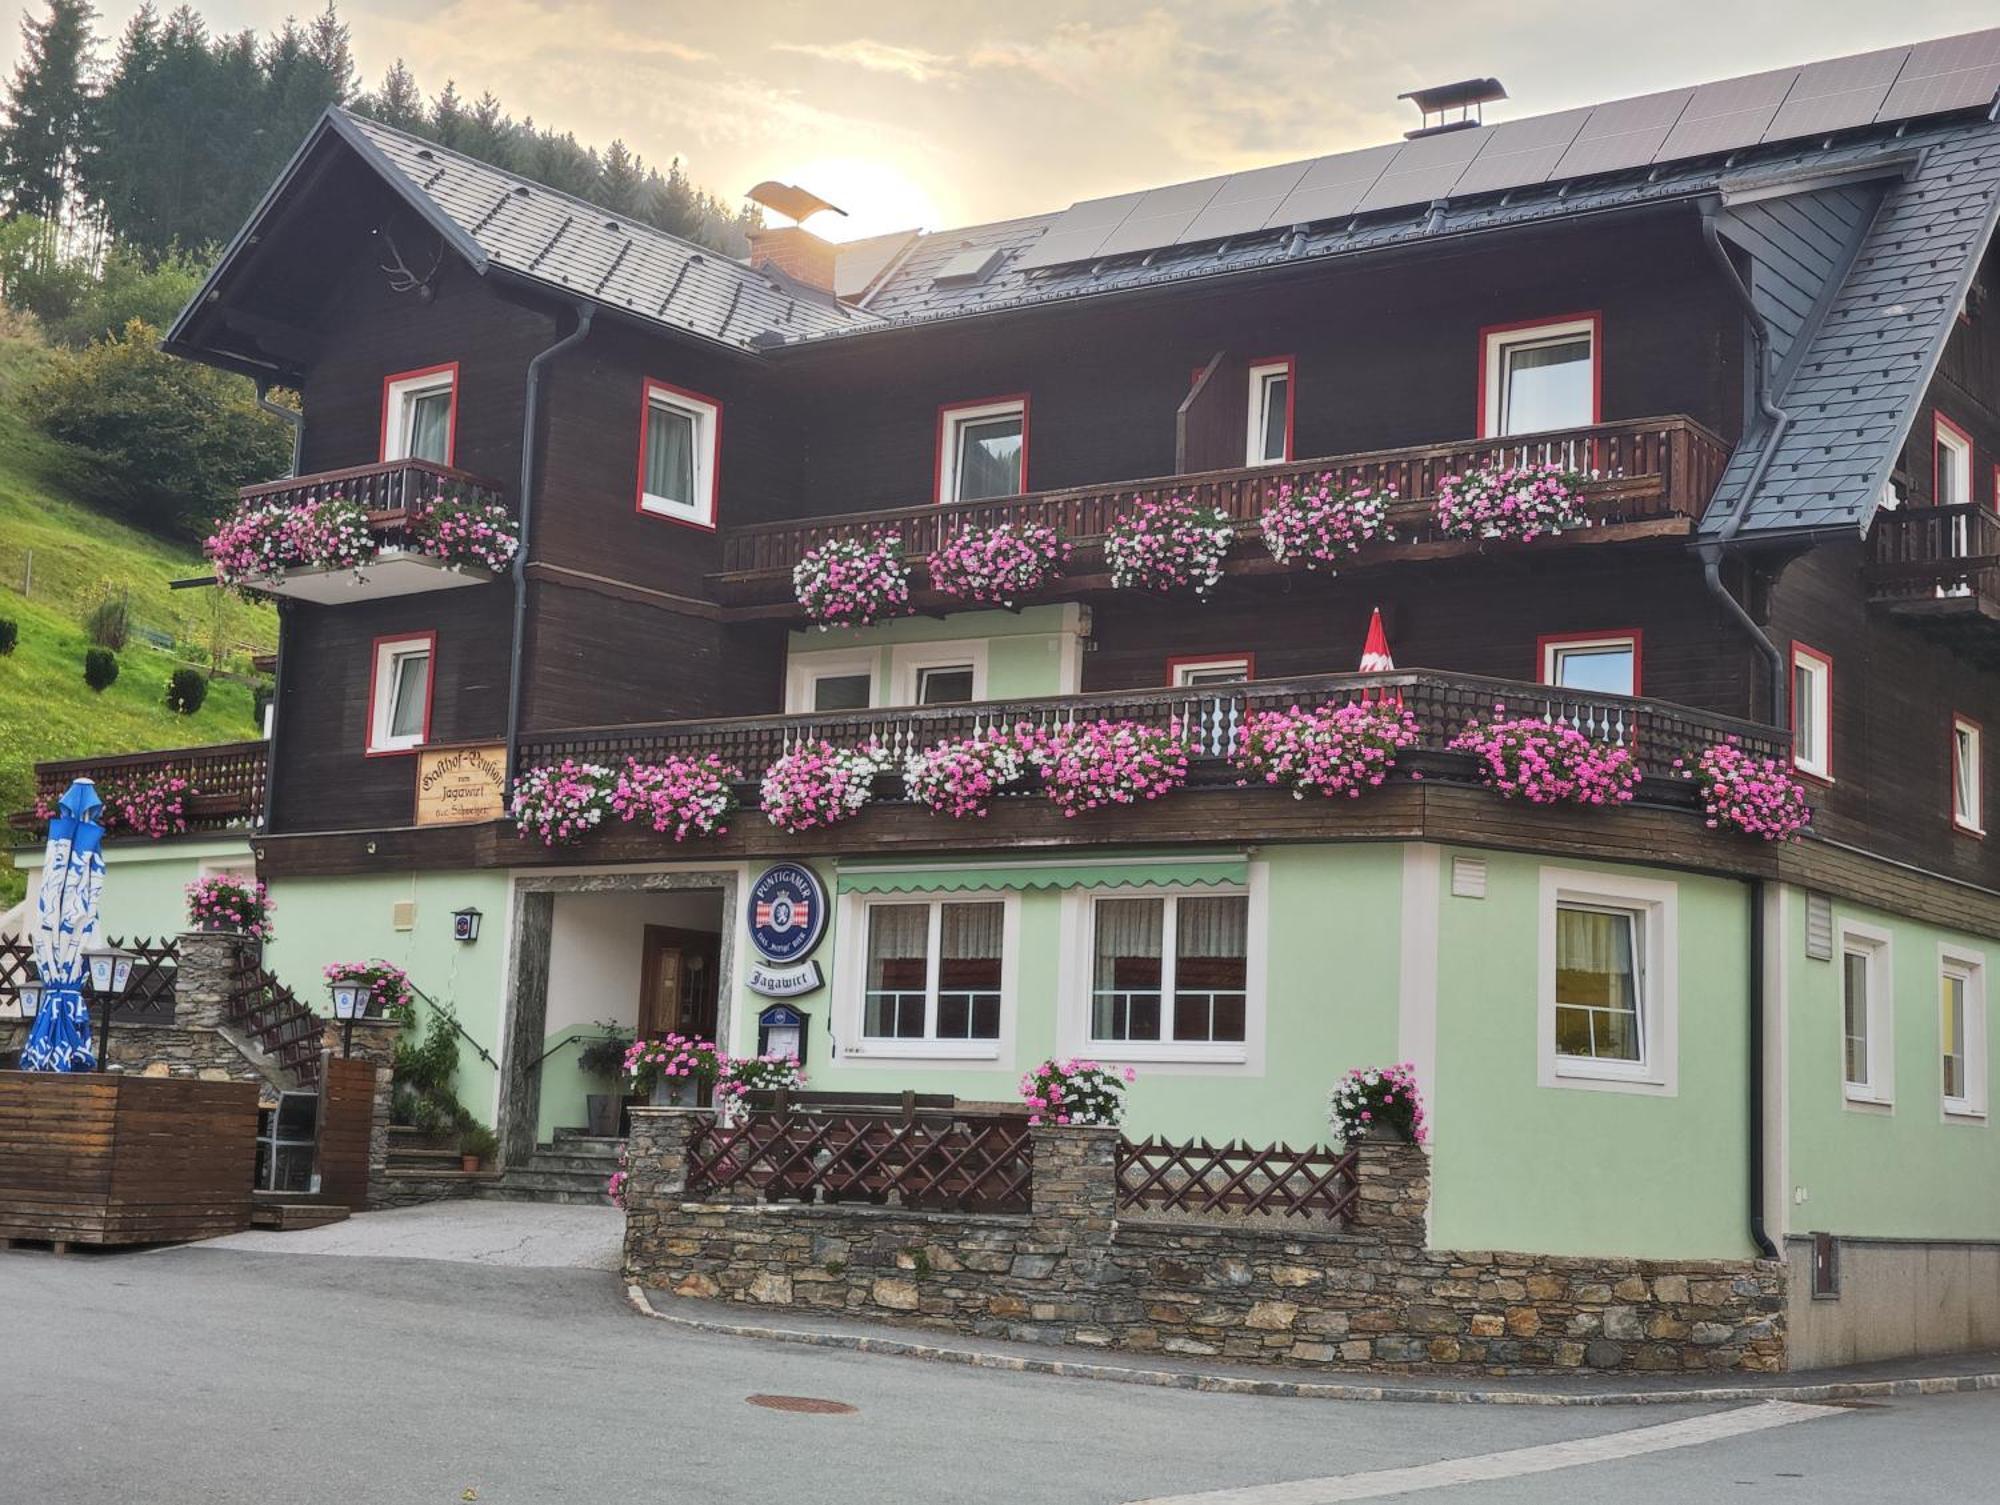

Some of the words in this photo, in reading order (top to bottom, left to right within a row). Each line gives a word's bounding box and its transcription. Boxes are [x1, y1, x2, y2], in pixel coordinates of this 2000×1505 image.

[442, 786, 484, 801] Jagawirt
[757, 871, 811, 898] PUNTIGAMER
[751, 971, 808, 990] Jagawirt
